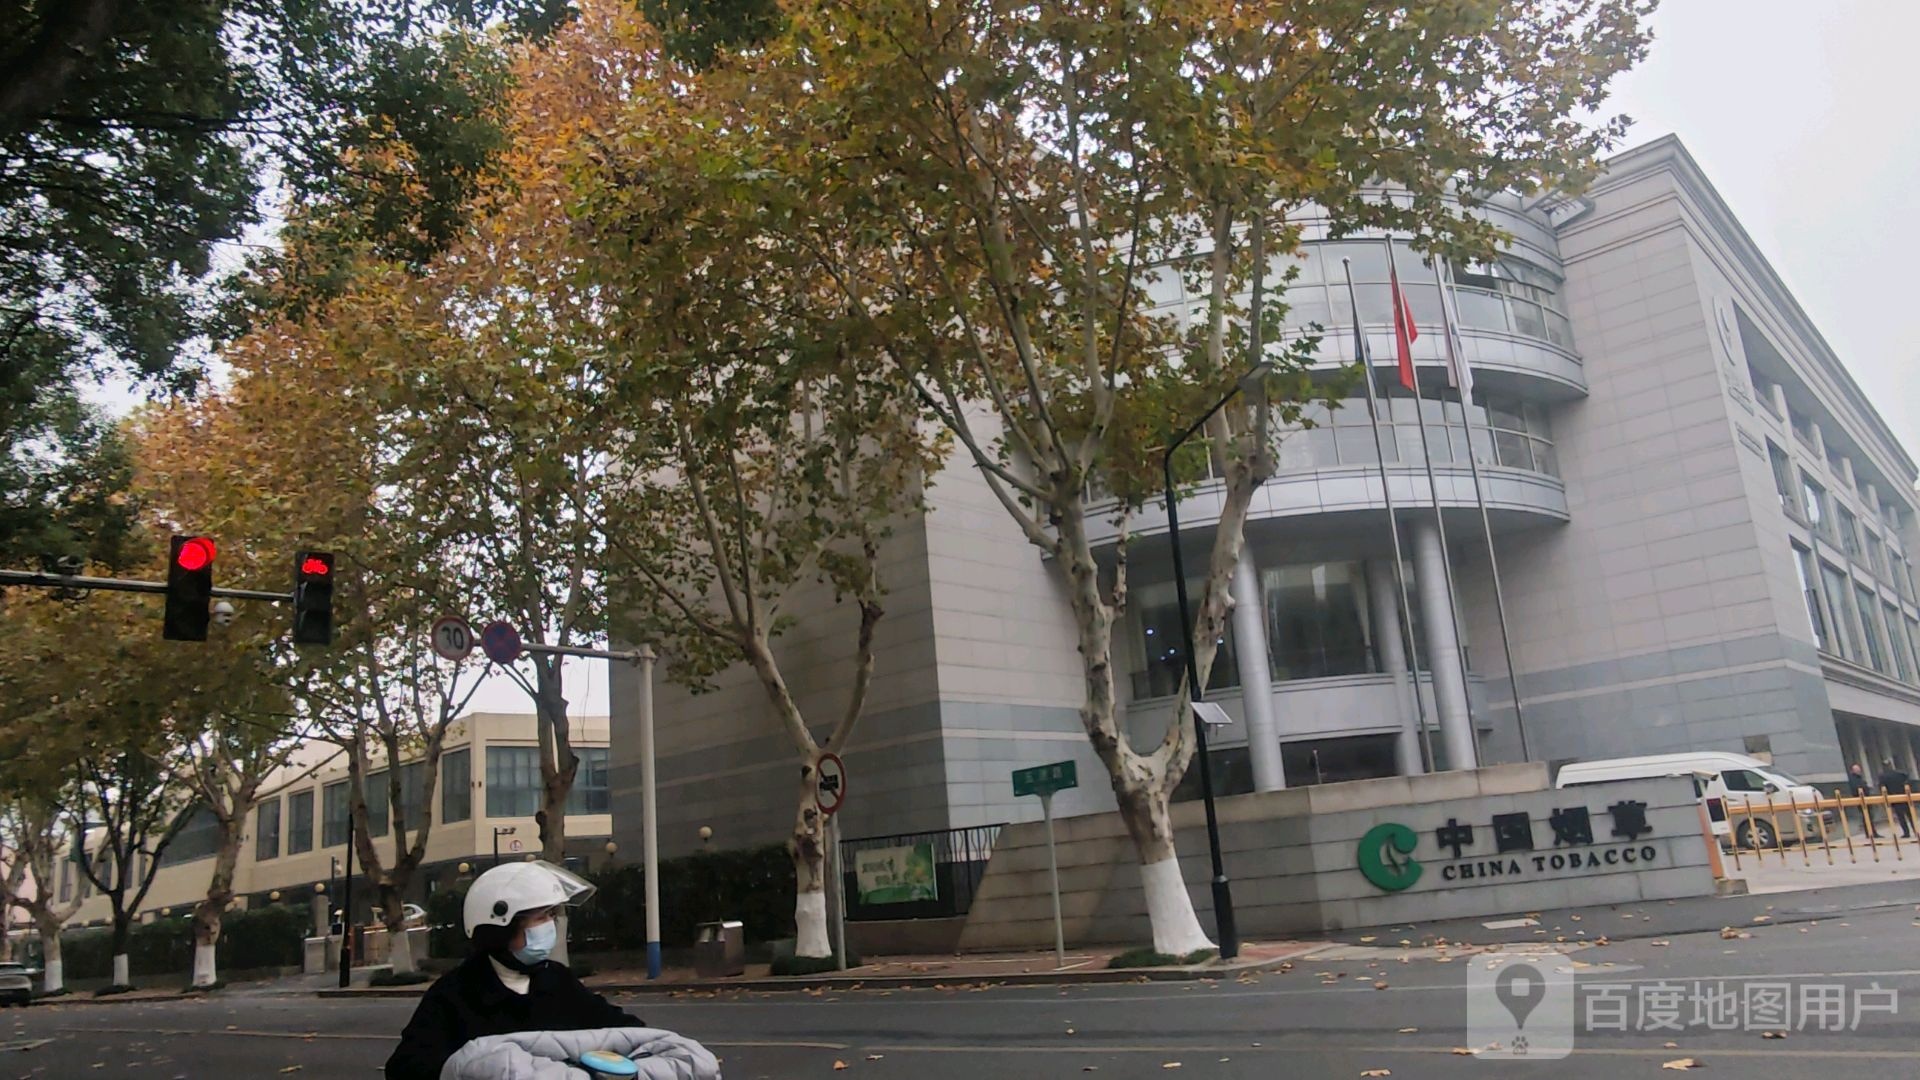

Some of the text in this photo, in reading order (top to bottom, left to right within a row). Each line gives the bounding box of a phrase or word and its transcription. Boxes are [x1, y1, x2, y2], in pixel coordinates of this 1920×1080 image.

[441, 627, 464, 650] 30
[1436, 800, 1653, 858] 中国烟草
[1442, 846, 1656, 881] CHINA TOBACCO
